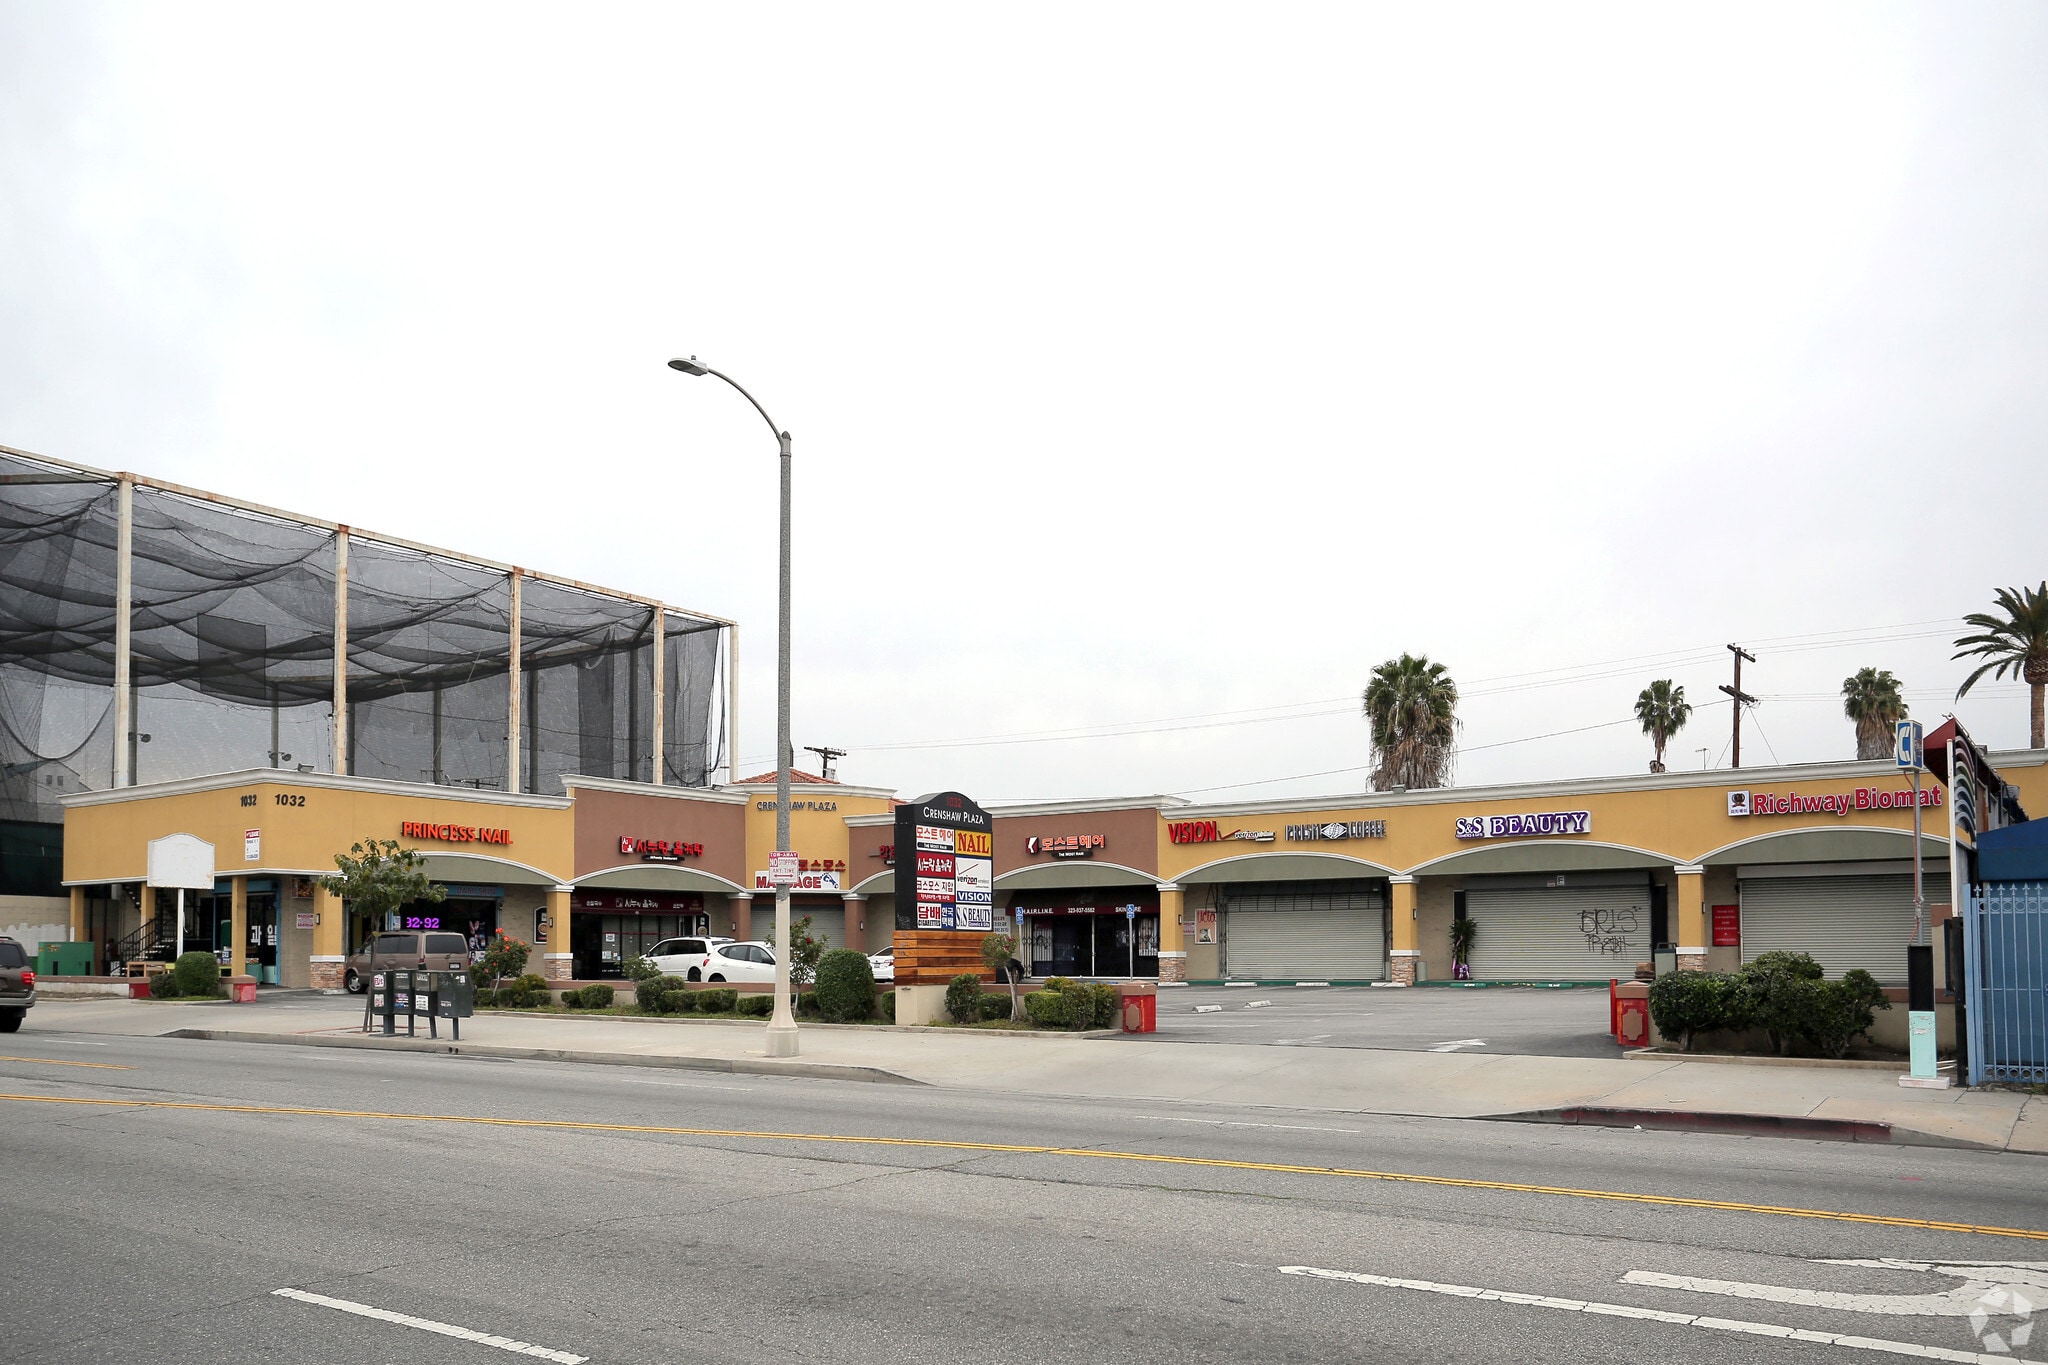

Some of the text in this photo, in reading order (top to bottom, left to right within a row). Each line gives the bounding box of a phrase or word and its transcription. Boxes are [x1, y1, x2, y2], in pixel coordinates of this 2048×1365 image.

[240, 795, 257, 807] 1032
[275, 794, 306, 807] 1032
[756, 802, 837, 812] CRENAW PLAZA
[1753, 784, 1943, 816] Richway Biomat
[923, 806, 984, 824] CRENSHAW PLAZA
[1456, 812, 1587, 835] S&S BEAUTY
[402, 821, 513, 844] PRINCESS NAIL
[1168, 821, 1217, 843] VISION
[1235, 830, 1258, 839] verizon
[1285, 823, 1320, 841] PRISM
[957, 832, 990, 854] NAIL
[769, 858, 778, 867] NO
[756, 876, 822, 889] MAGE
[957, 875, 978, 885] verizon
[957, 891, 992, 902] VISION
[918, 906, 941, 920] 담배
[968, 908, 992, 922] BEAUTY
